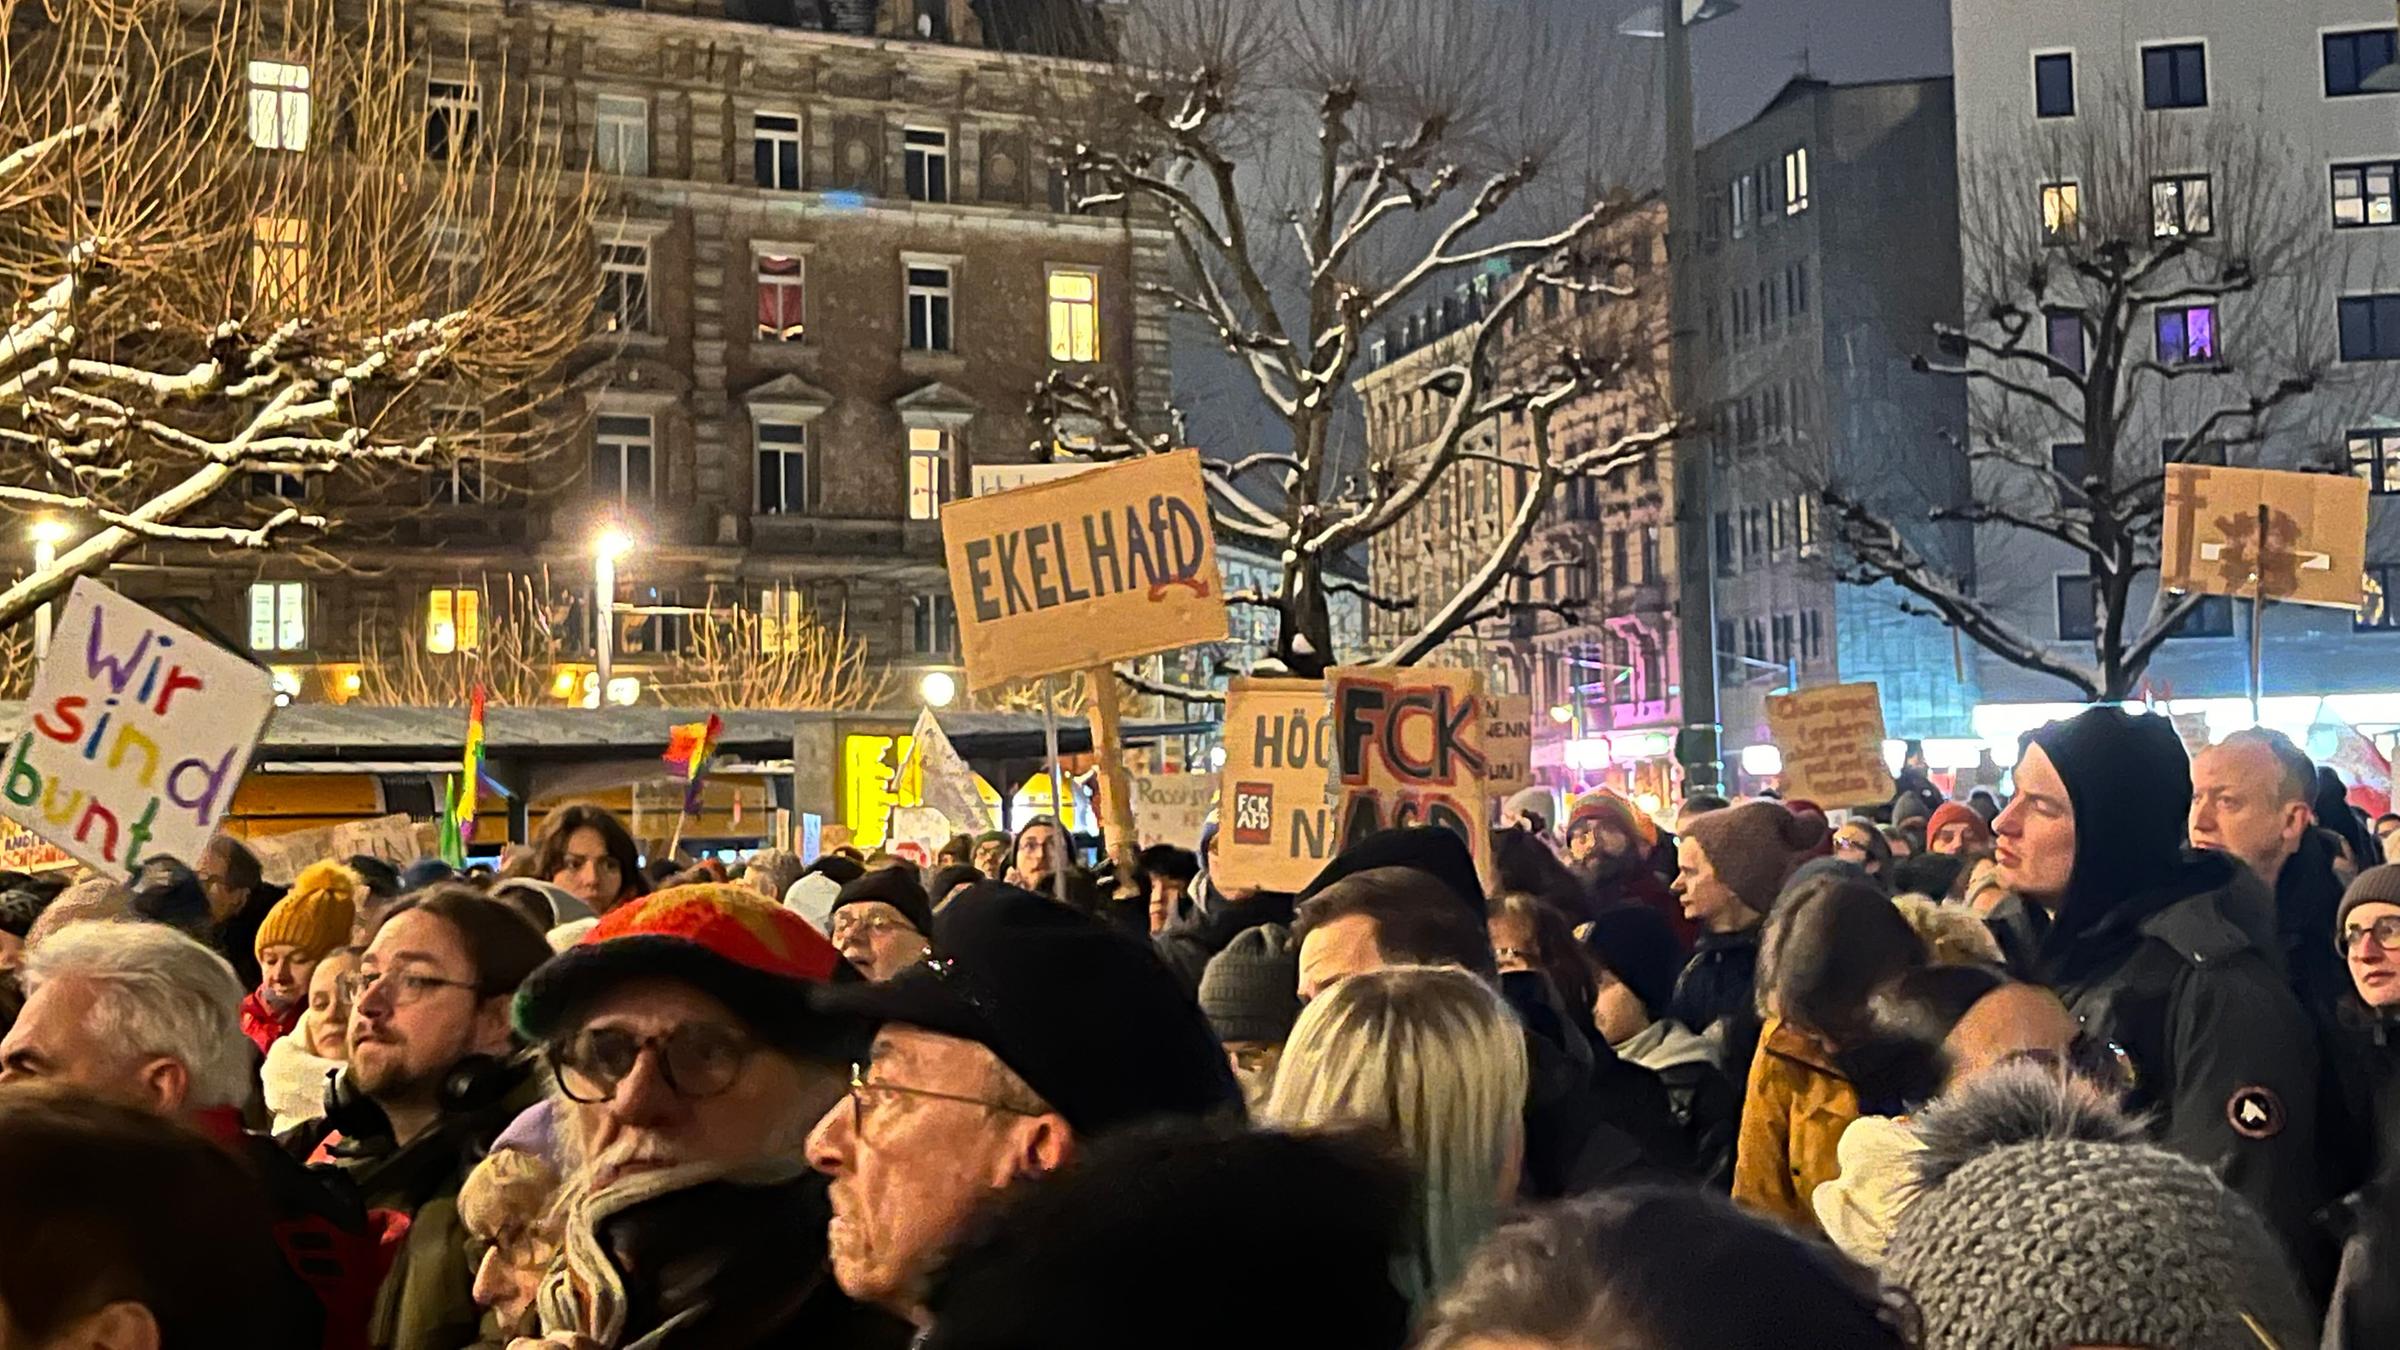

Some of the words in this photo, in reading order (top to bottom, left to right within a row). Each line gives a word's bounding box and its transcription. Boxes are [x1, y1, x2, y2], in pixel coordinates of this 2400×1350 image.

[86, 604, 204, 716] Wir
[33, 696, 238, 826] sind
[1335, 677, 1487, 786] FCK
[5, 731, 160, 876] bunt
[1236, 811, 1270, 830] AFD
[1237, 793, 1269, 813] FCK
